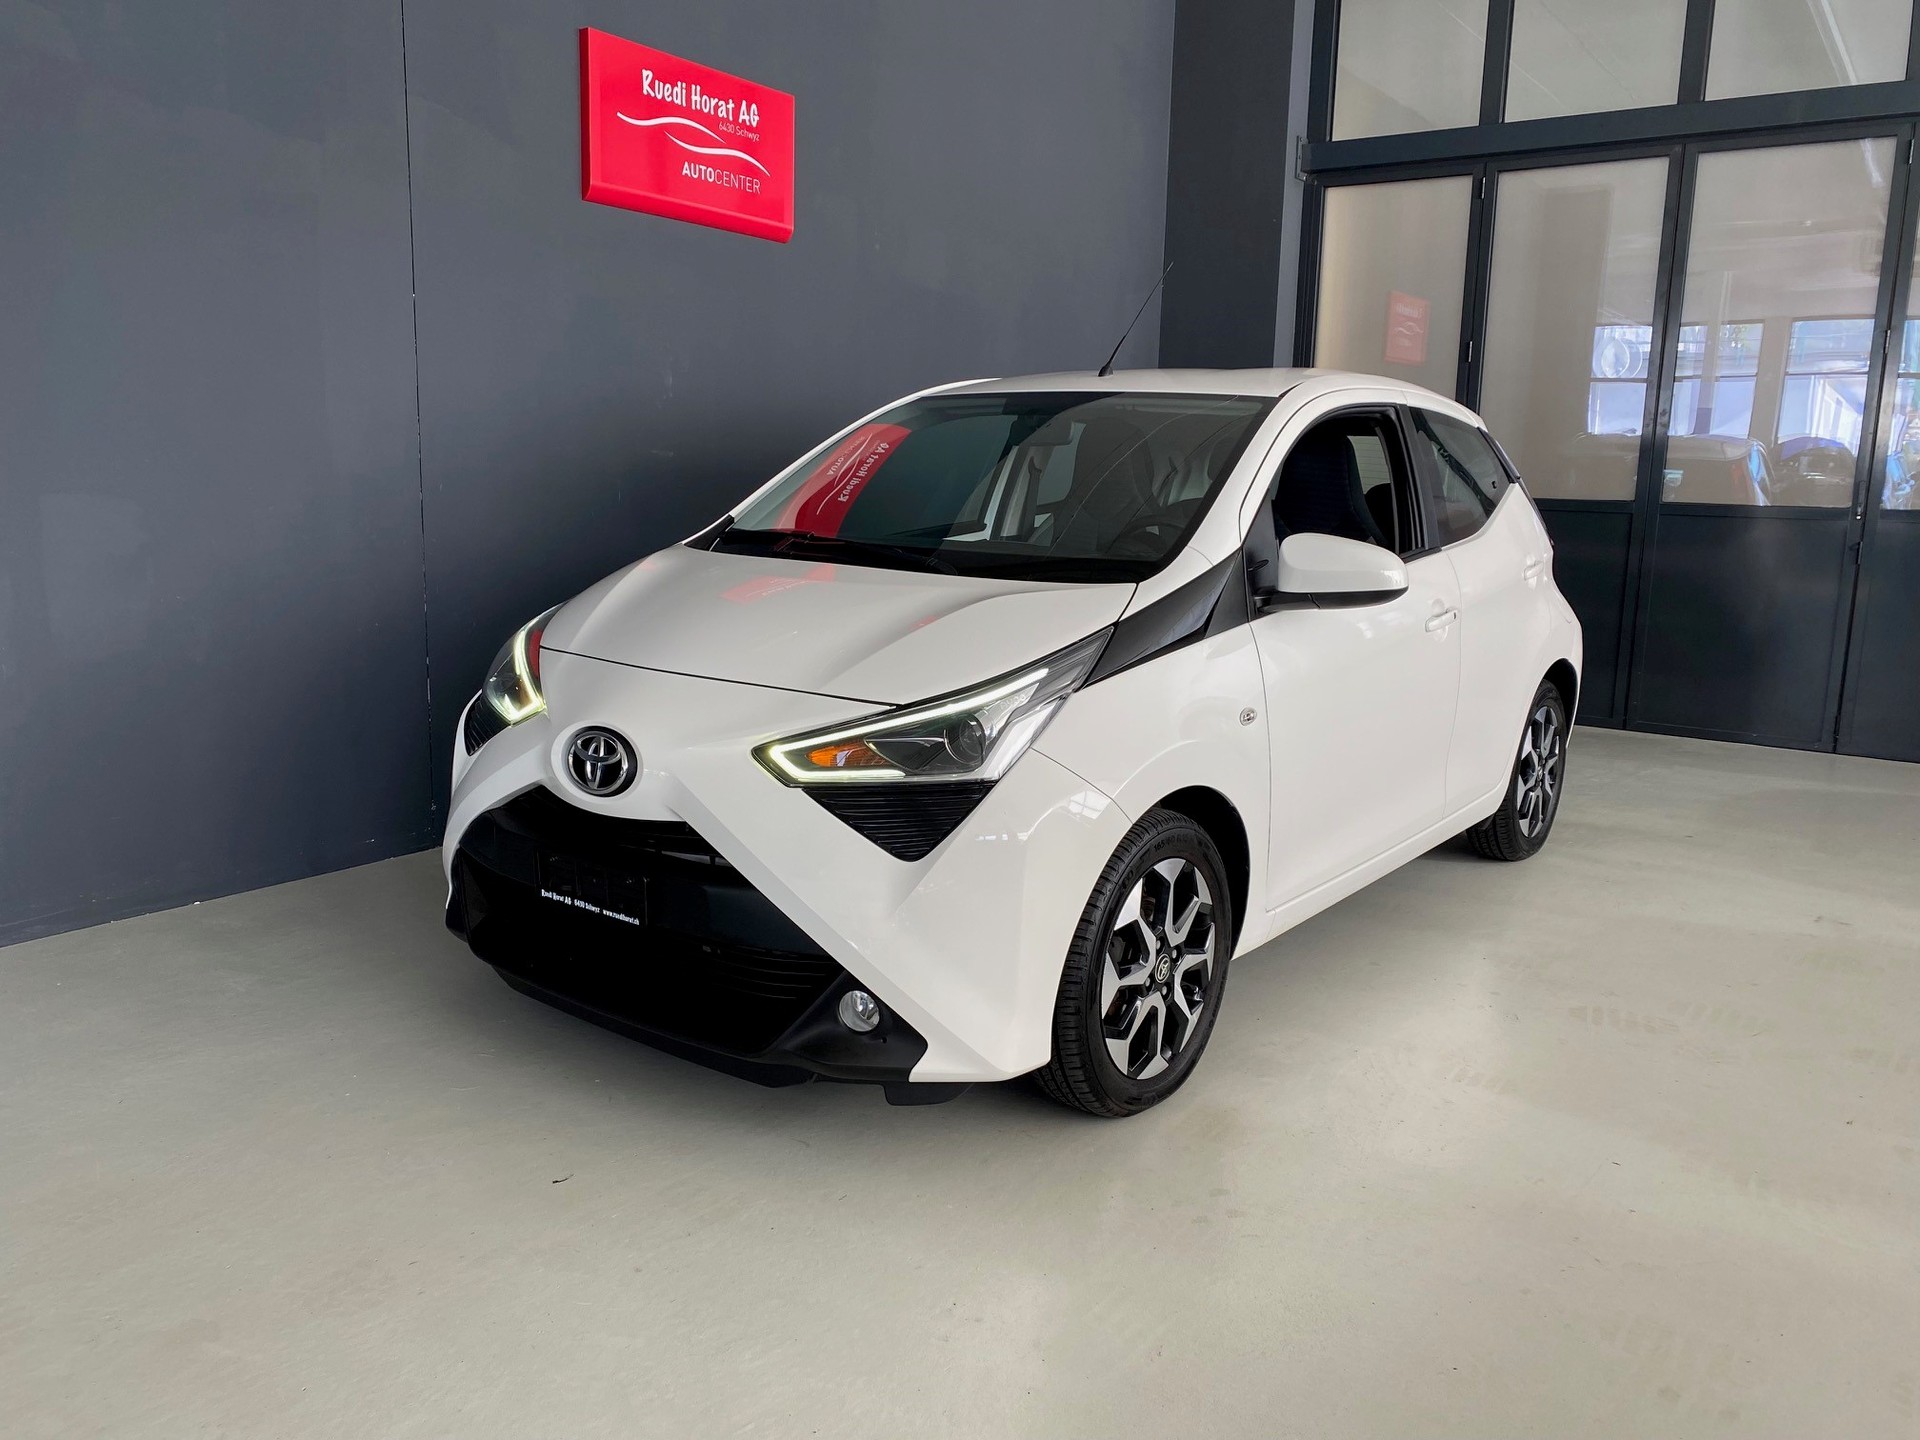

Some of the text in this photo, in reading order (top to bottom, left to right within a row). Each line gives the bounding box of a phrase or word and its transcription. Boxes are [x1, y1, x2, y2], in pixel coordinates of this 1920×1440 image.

[641, 68, 760, 128] Ruedi Horat AG
[718, 121, 760, 142] 6430 Schwyz
[681, 161, 761, 194] AUTOCENTER
